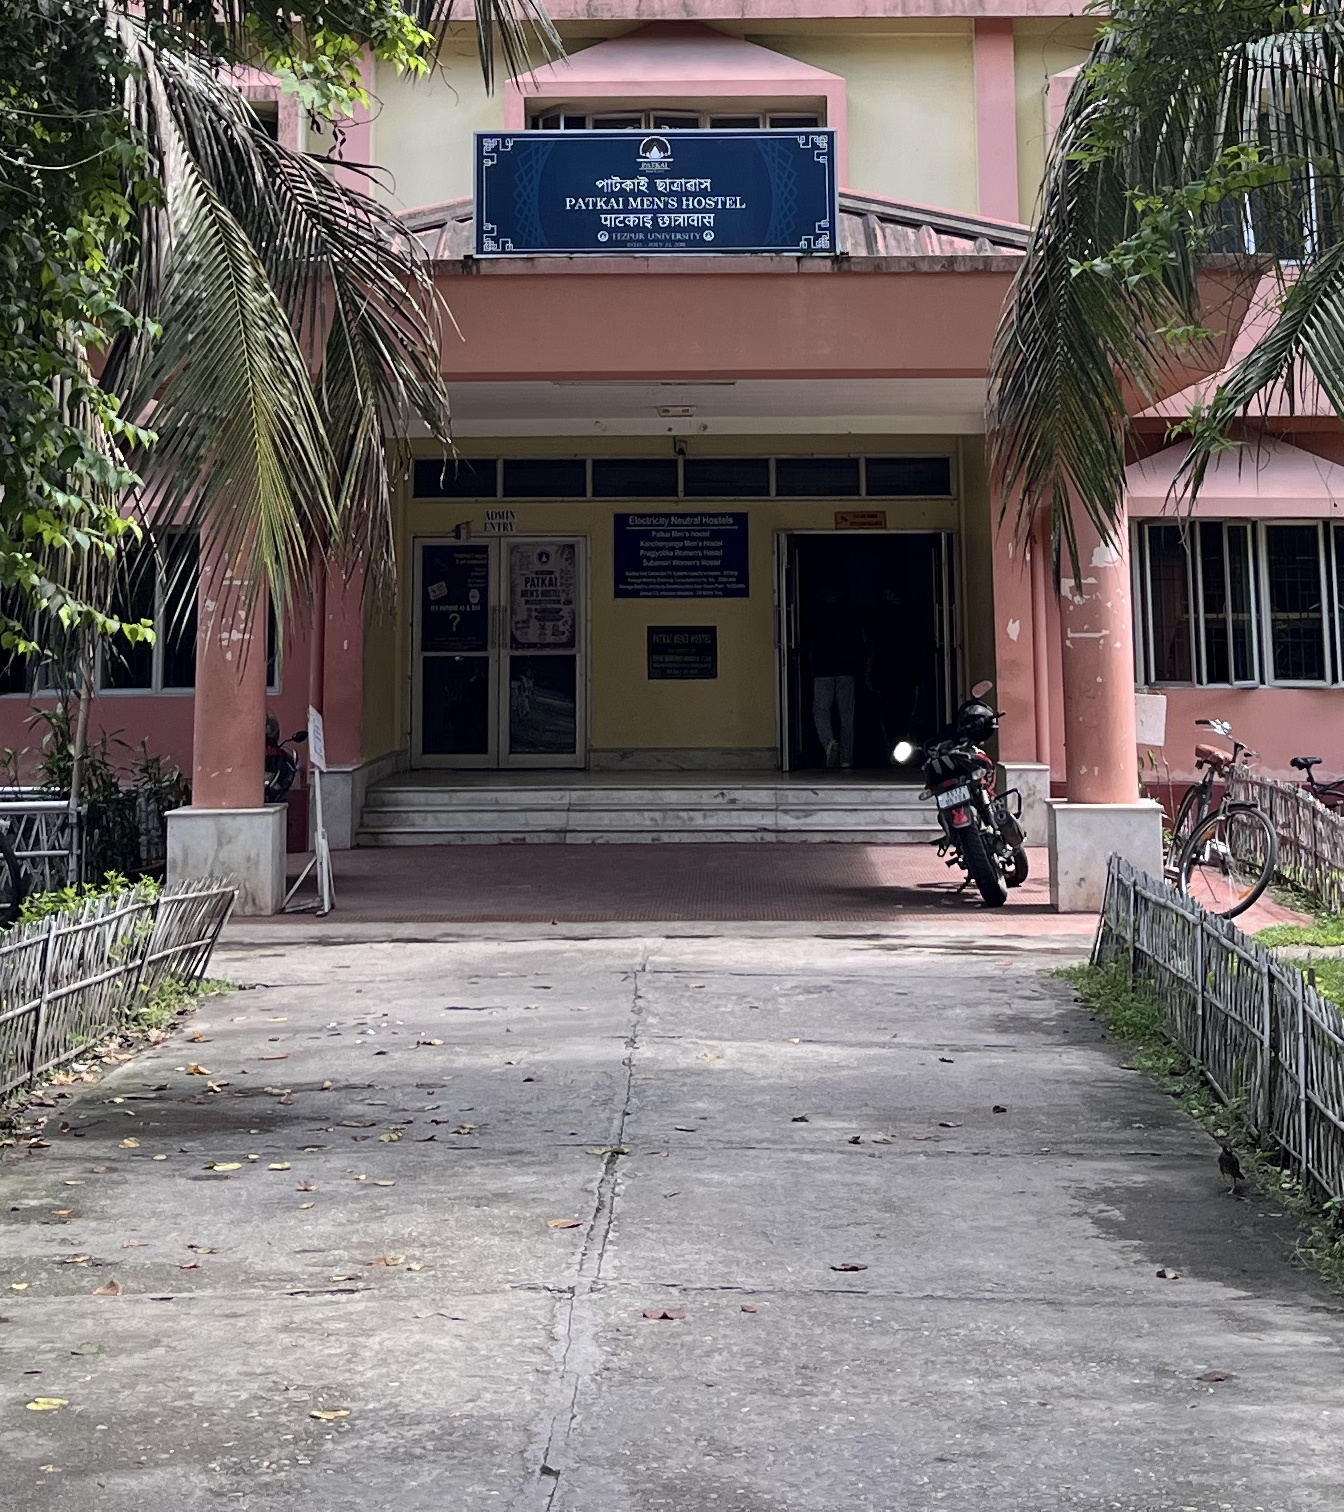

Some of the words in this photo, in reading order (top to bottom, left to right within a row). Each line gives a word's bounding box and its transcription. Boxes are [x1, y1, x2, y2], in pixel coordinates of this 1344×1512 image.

[595, 175, 650, 193] পাটকাই
[565, 197, 623, 210] PATKAI
[627, 197, 678, 210] MEN'S
[682, 196, 746, 209] HOSTEL
[656, 213, 715, 228] छात्रावास
[611, 232, 645, 240] TEZPUR
[647, 232, 701, 240] UNIVERSITY
[485, 510, 515, 520] ADMIN
[484, 521, 514, 532] ENTRY
[628, 515, 670, 528] Electricity
[670, 515, 701, 525] Neutral
[702, 515, 734, 525] Hostels
[524, 576, 558, 588] PATKAI
